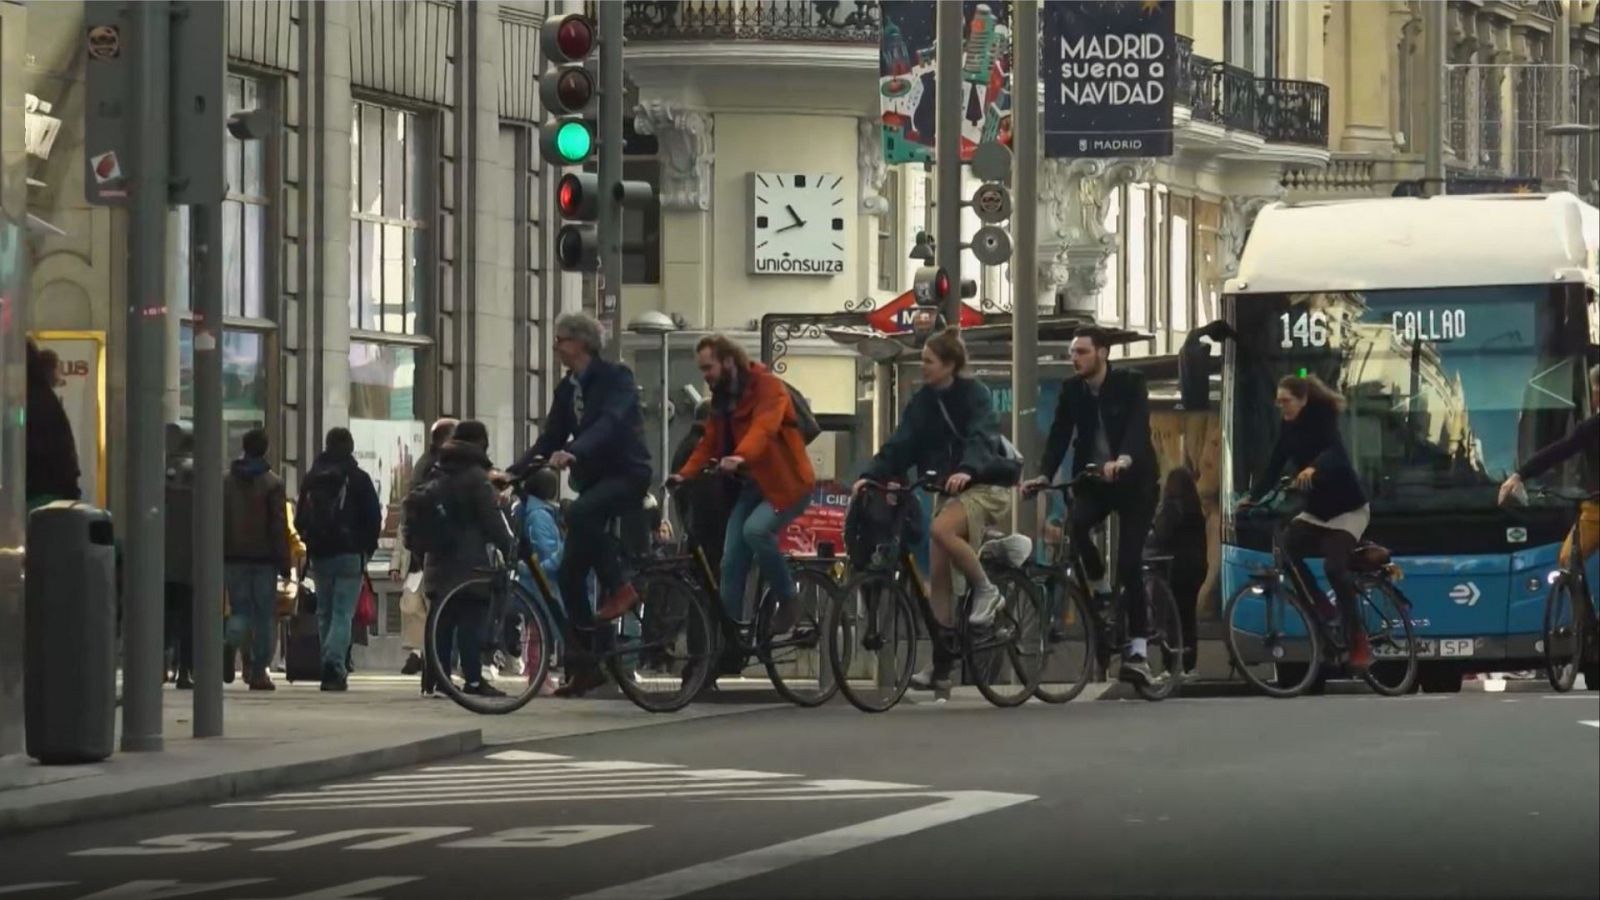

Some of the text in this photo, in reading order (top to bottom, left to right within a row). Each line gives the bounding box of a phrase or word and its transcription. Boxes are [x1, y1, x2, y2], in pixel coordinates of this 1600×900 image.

[1061, 33, 1164, 59] MADRID
[1061, 61, 1164, 79] suena a
[1061, 81, 1164, 105] NAVIDAD
[1094, 140, 1142, 149] MADRID
[1280, 309, 1466, 348] 146 CALLAO
[1444, 641, 1470, 655] SP
[66, 824, 655, 856] BUS
